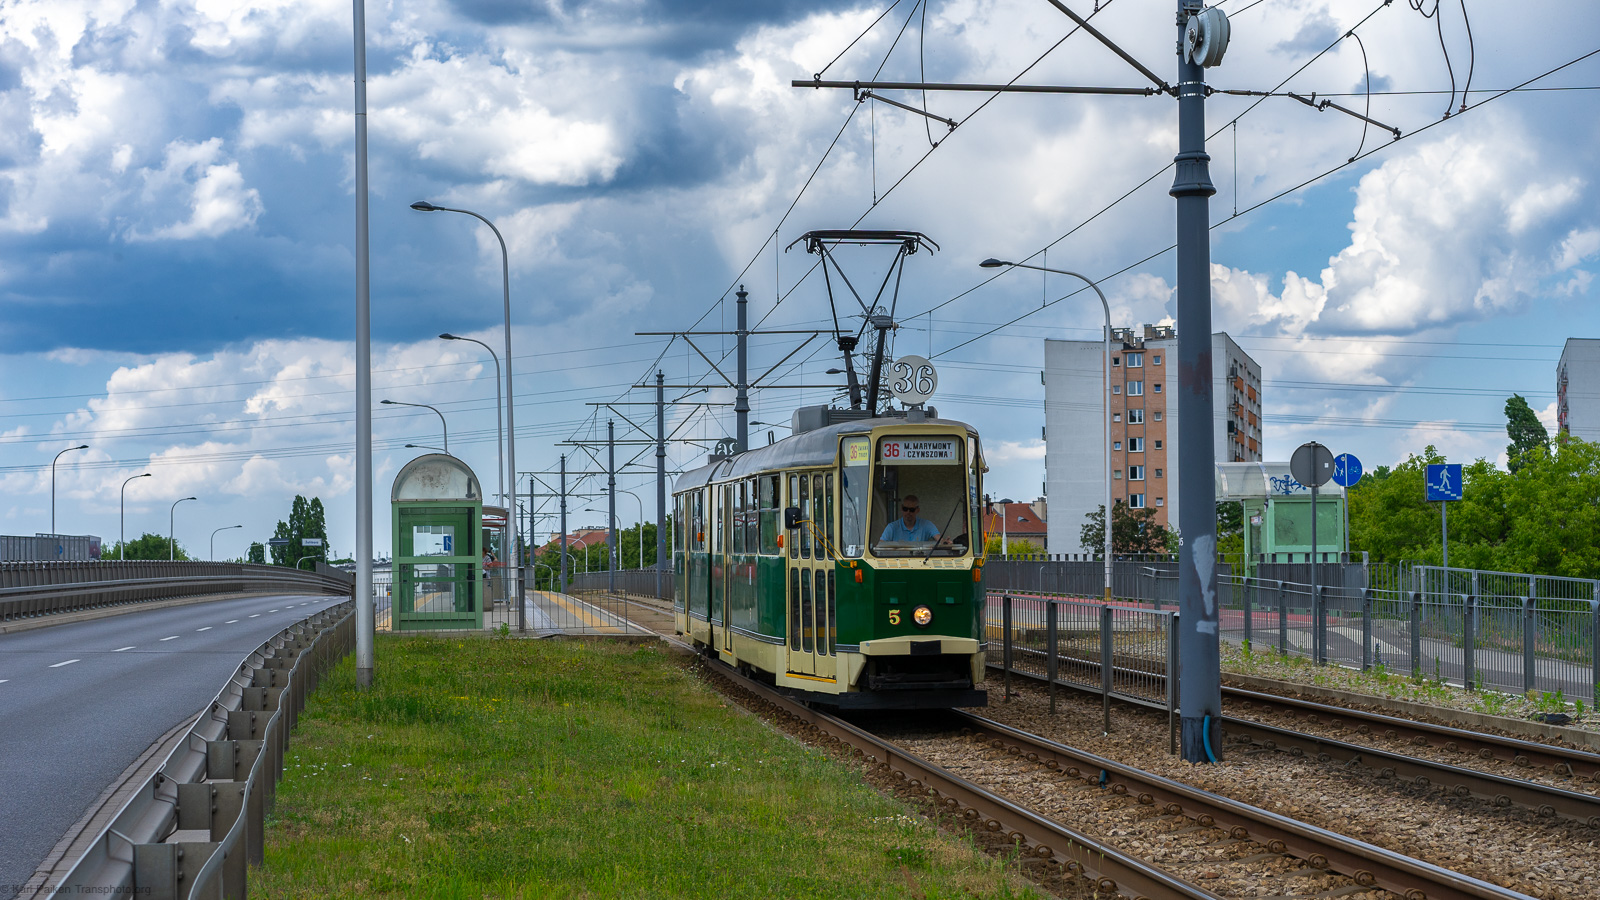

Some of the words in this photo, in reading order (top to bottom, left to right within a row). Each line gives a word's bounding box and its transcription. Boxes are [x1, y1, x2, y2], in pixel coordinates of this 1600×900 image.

[893, 362, 934, 395] 36
[850, 444, 858, 459] 36
[884, 443, 900, 458] 36
[888, 609, 901, 625] 5
